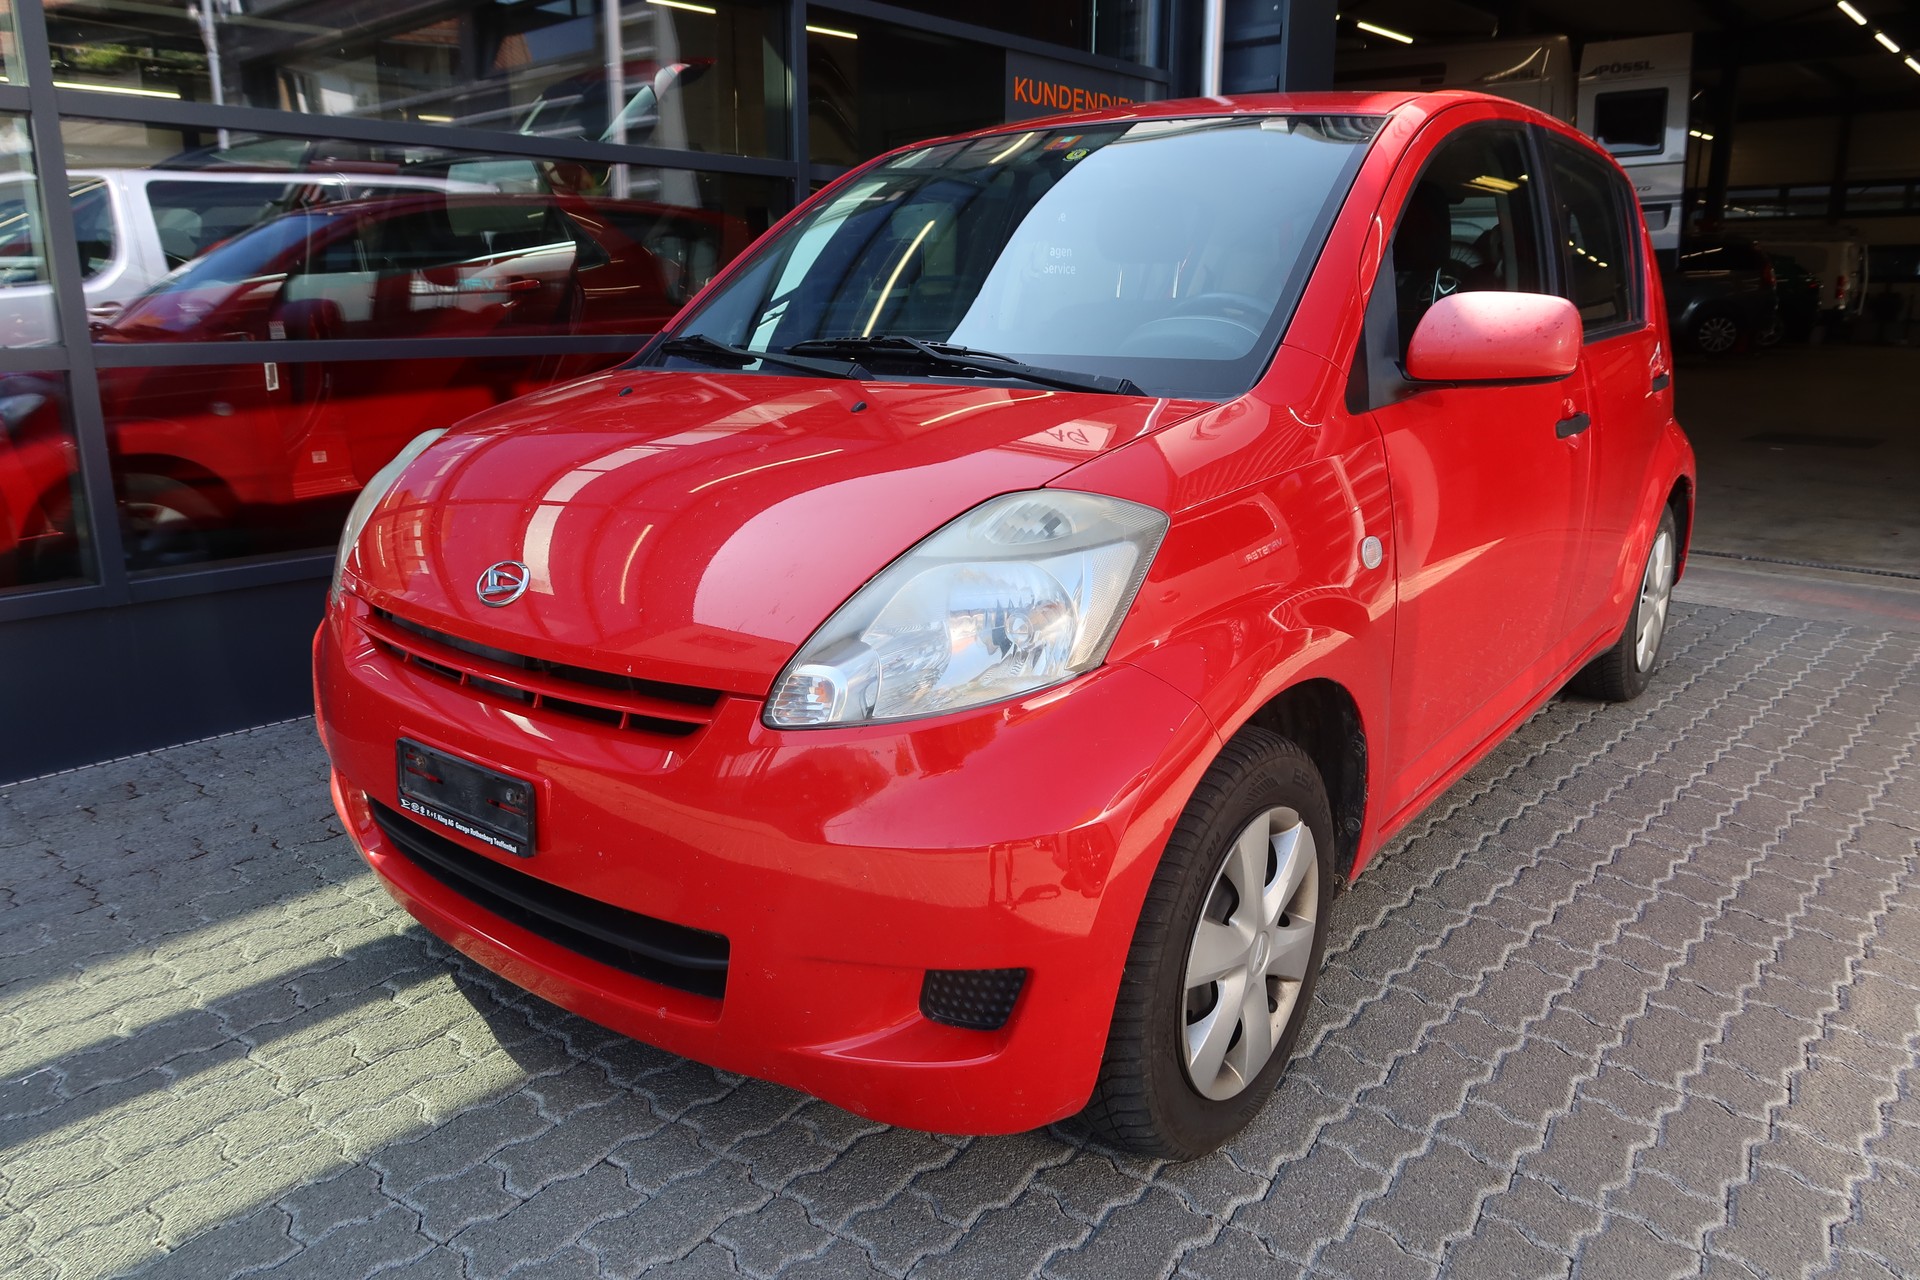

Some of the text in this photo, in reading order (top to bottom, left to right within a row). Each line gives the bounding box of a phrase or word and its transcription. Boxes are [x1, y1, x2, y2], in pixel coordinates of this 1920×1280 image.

[1049, 246, 1072, 259] agen
[1043, 262, 1076, 274] Service
[455, 821, 470, 834] Garage
[1181, 863, 1206, 923] 175/65
